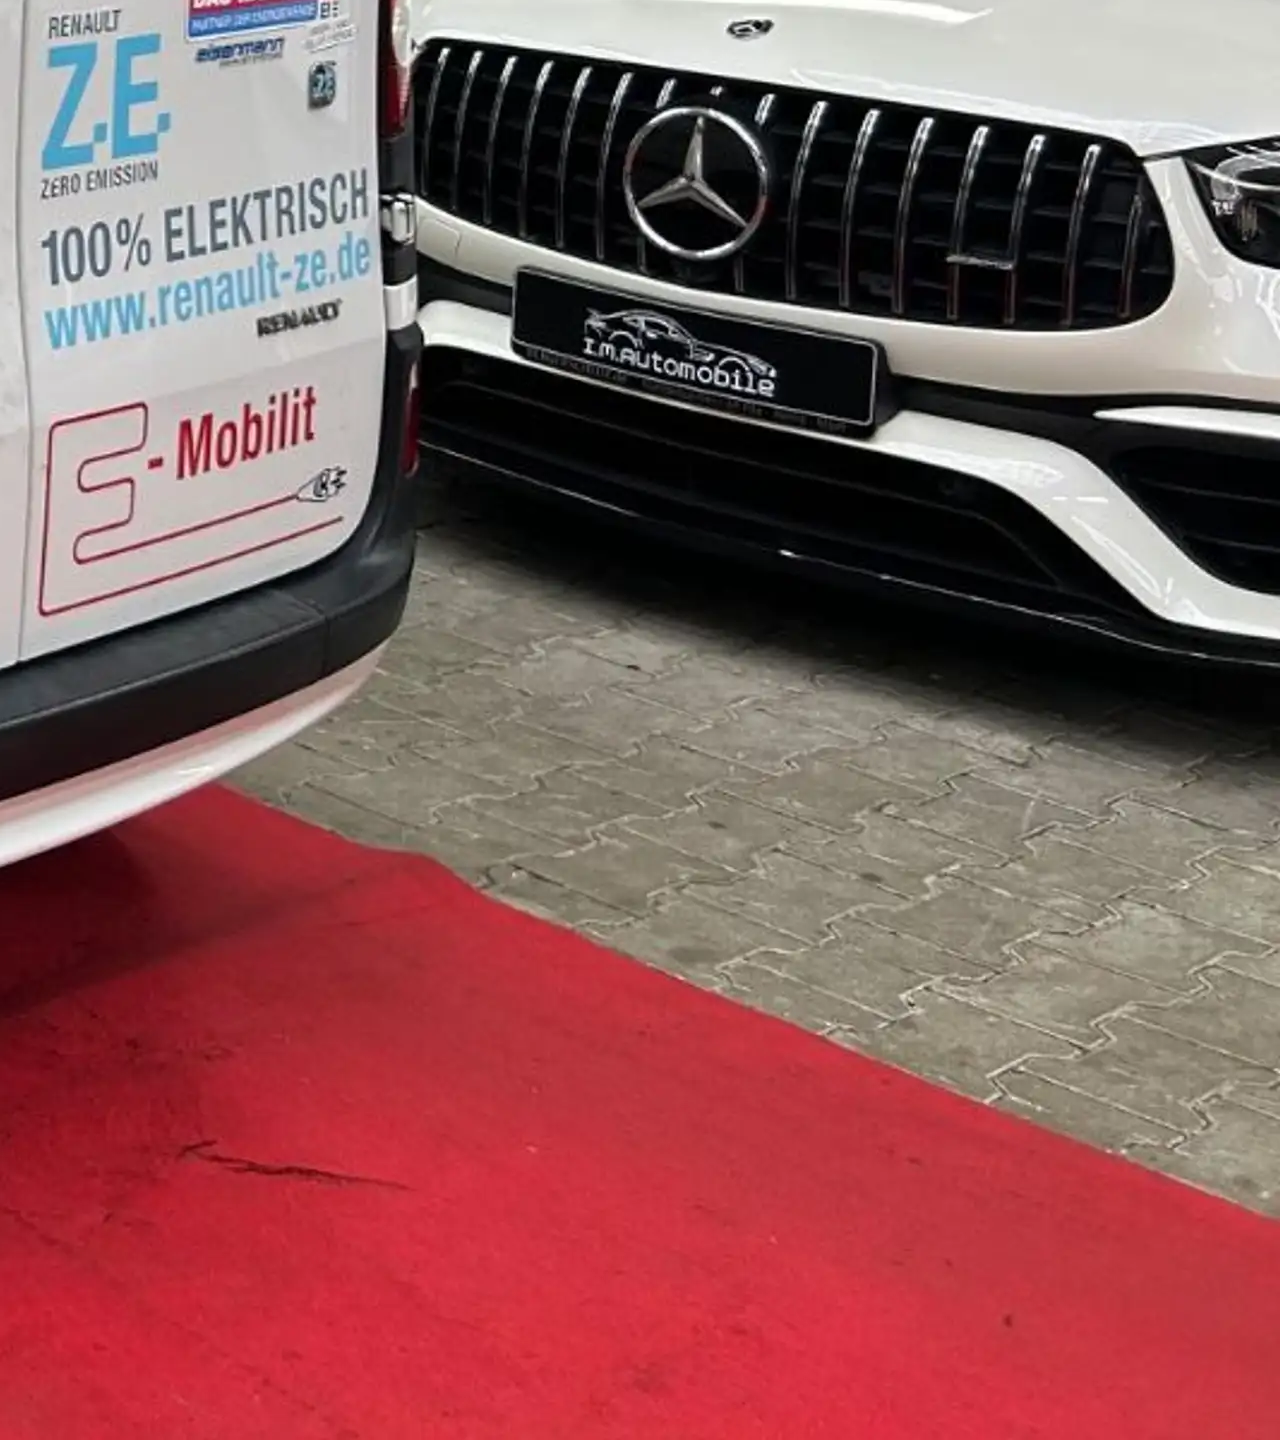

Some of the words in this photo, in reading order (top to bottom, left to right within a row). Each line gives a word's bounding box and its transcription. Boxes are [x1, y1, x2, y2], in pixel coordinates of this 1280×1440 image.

[48, 9, 123, 39] RENAULT
[41, 33, 171, 170] Z.E.
[40, 170, 82, 200] ZERO
[85, 161, 159, 193] EMISSION
[41, 213, 152, 287] 100%
[163, 168, 370, 264] ELEKTRISCH
[44, 231, 372, 350] www.renault-ze.de
